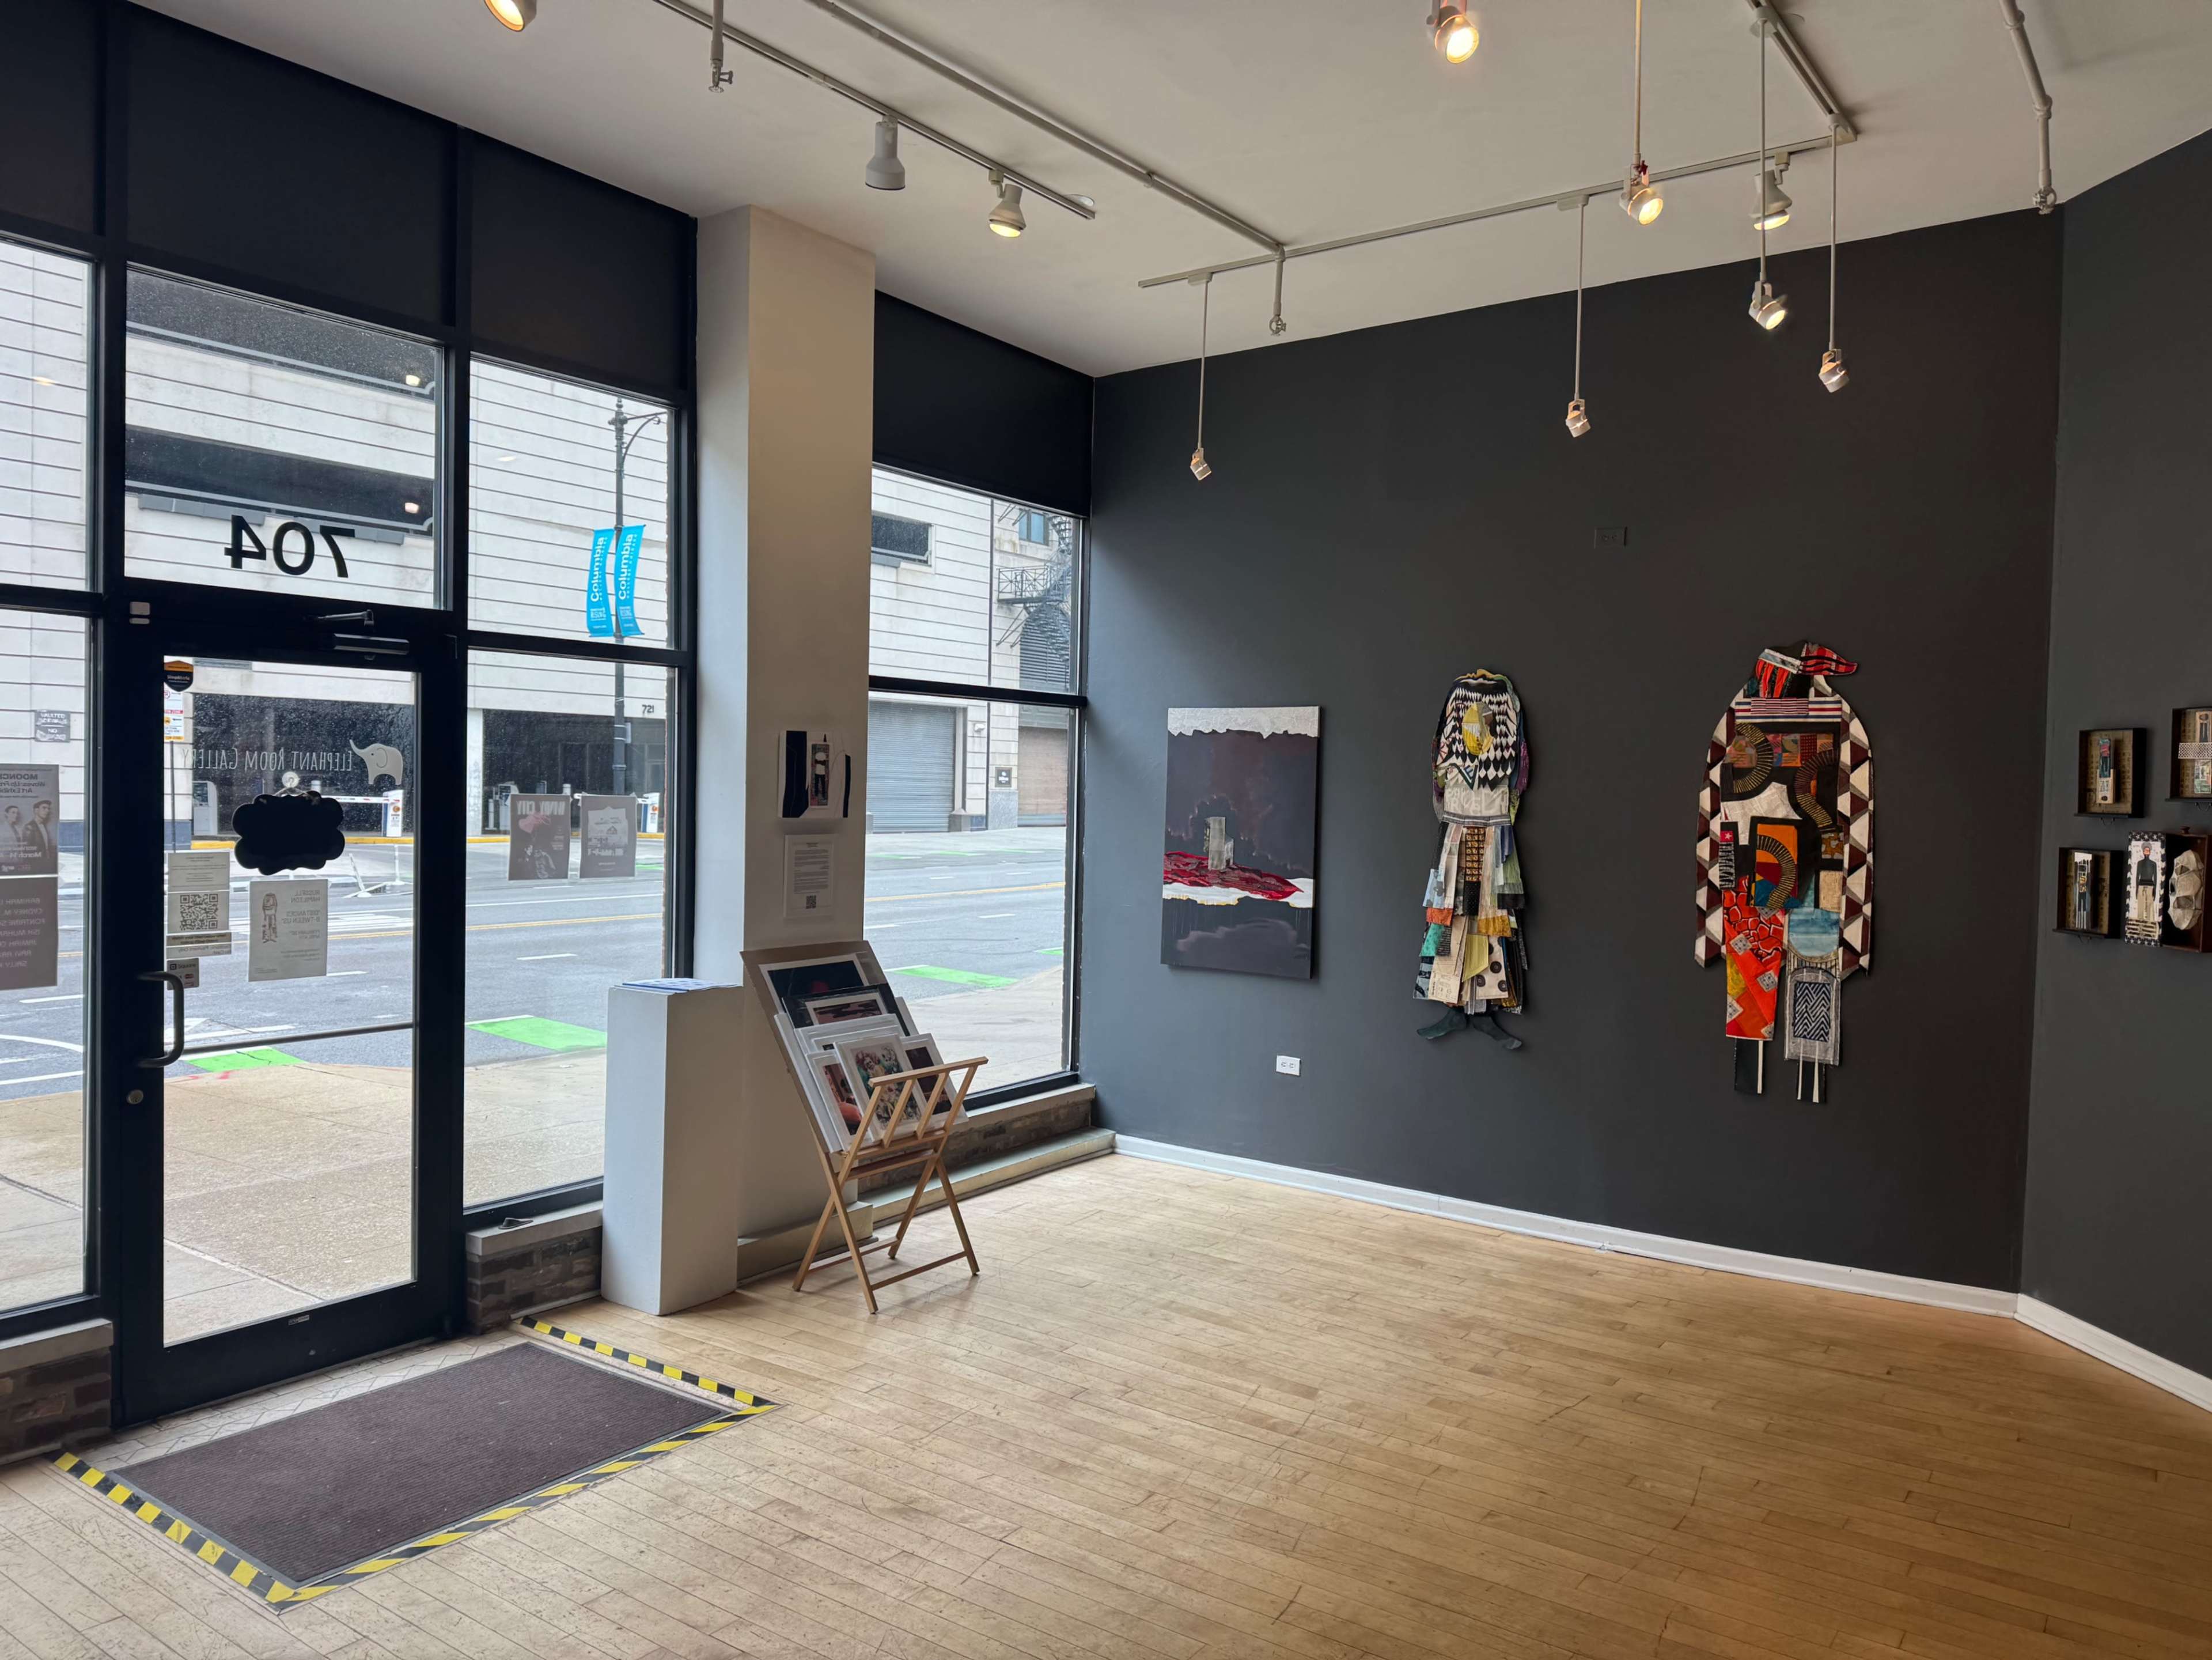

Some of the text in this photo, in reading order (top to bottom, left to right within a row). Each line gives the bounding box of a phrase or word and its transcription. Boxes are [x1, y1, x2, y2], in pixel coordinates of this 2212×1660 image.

[590, 537, 604, 602] Columbia
[618, 534, 634, 600] Columbia
[642, 704, 654, 714] 721
